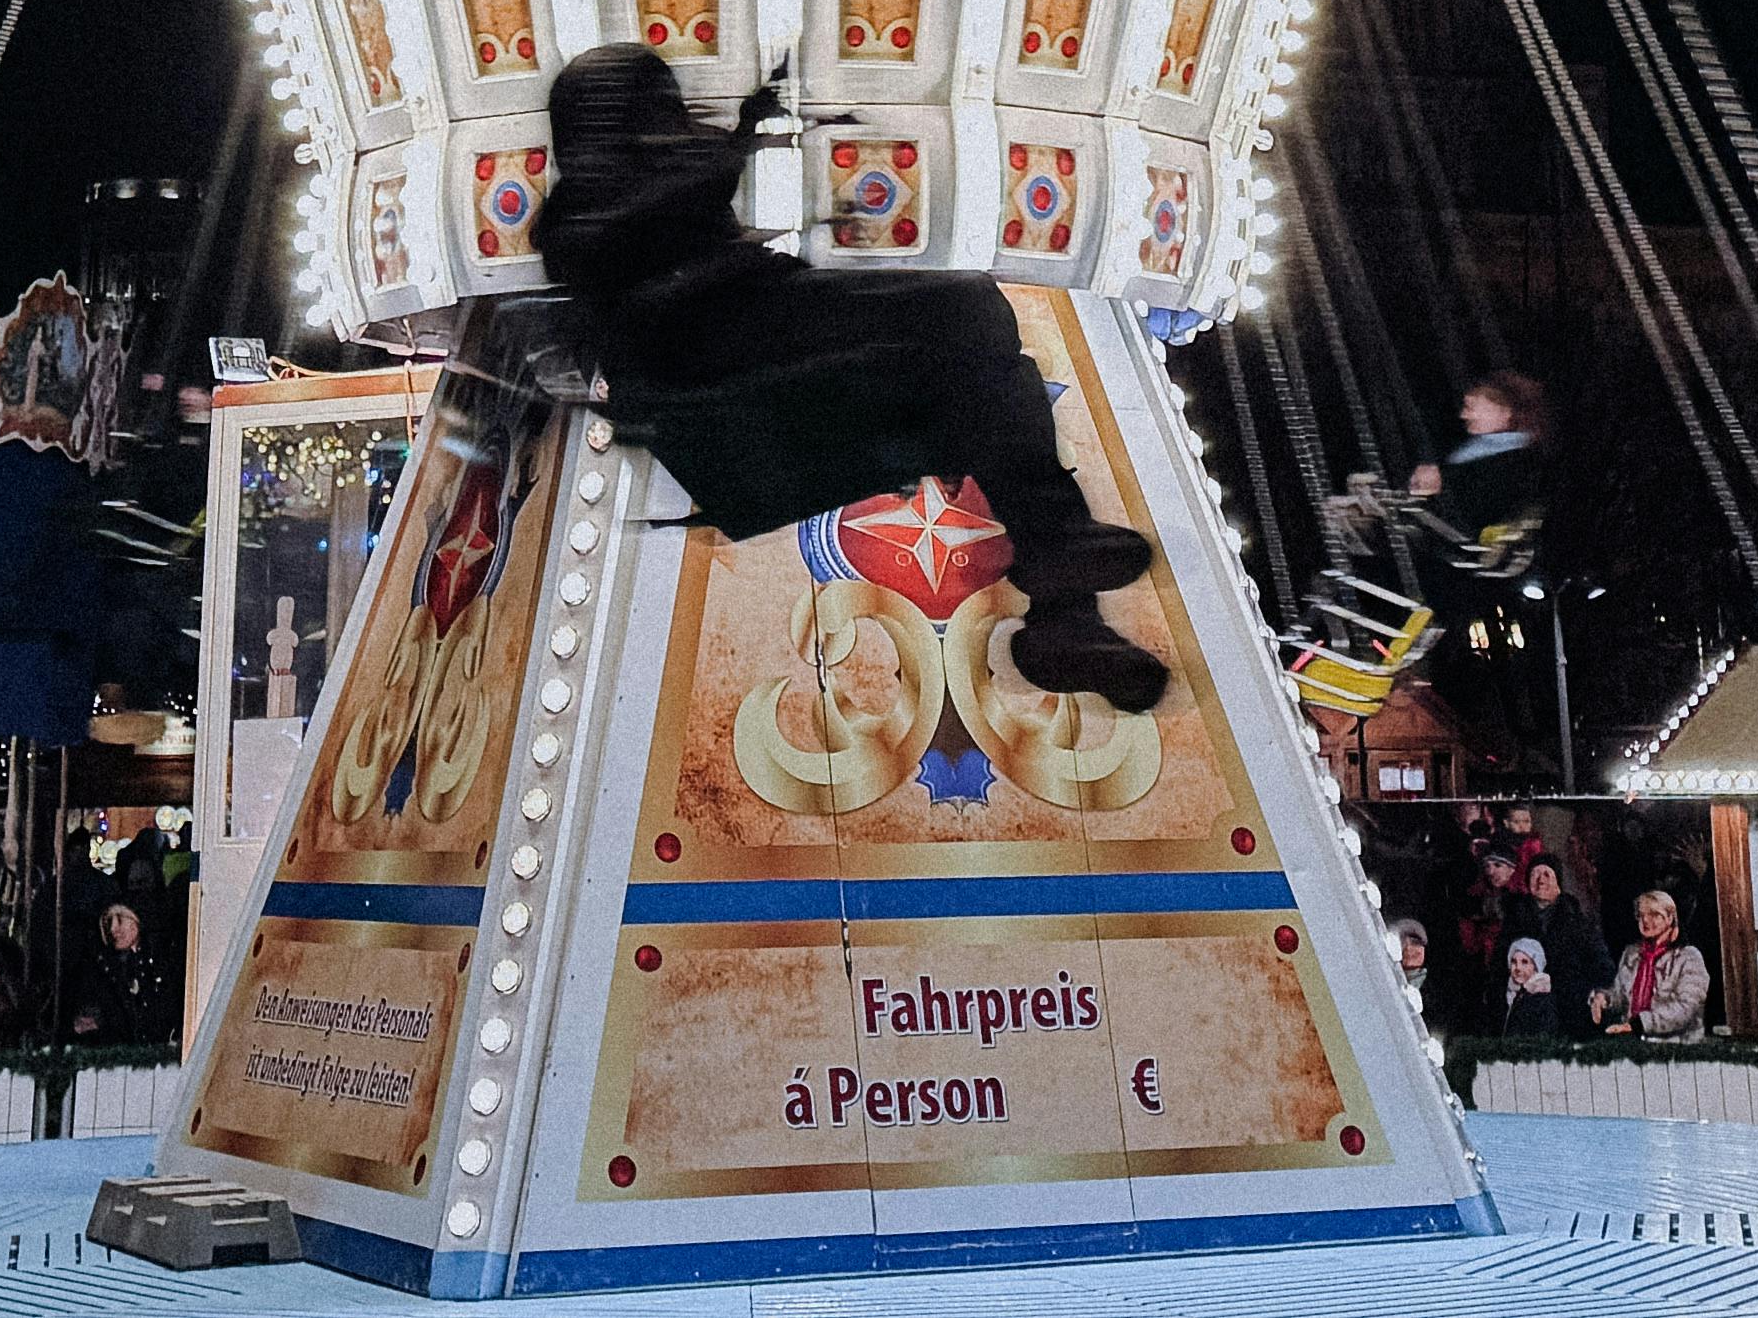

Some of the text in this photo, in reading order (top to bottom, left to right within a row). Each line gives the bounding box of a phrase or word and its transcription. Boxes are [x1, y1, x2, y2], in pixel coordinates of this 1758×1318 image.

[253, 985, 433, 1039] Den Anweisungen des Personals
[861, 969, 1101, 1046] Fahrpreis
[245, 1044, 417, 1105] ist unbedingt Folge zu leisten!
[784, 1058, 1162, 1127] á Person €
